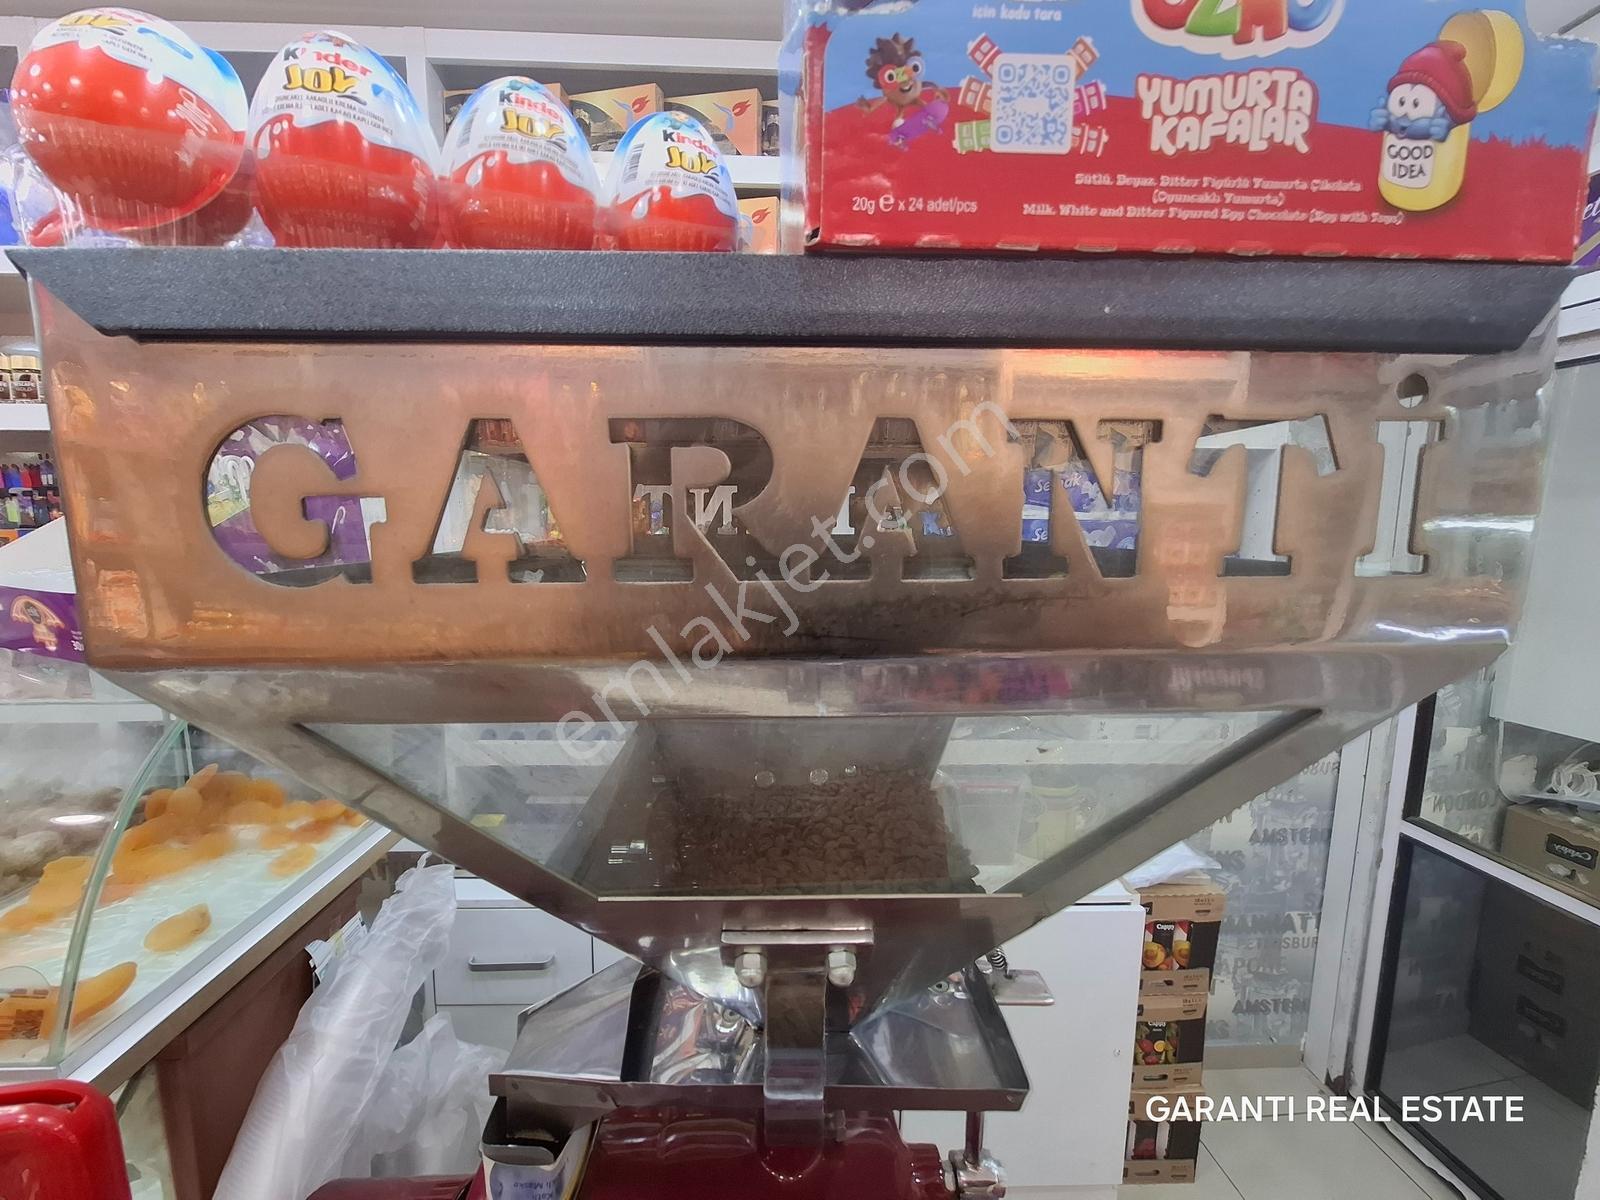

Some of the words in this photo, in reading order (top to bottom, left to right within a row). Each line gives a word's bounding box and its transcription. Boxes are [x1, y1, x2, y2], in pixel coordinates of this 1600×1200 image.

[283, 65, 360, 94] JOY
[1137, 70, 1314, 120] YUMURTA
[1150, 109, 1310, 155] KAFALAR
[665, 146, 718, 174] JOY
[1387, 143, 1434, 160] GOOD
[1391, 162, 1426, 179] IDEA
[1160, 175, 1200, 187] Bitter
[852, 196, 876, 215] 20g
[898, 201, 906, 212] x
[908, 197, 924, 212] 24
[1059, 204, 1098, 217] White
[1099, 205, 1125, 218] and
[1126, 206, 1167, 219] Bitter
